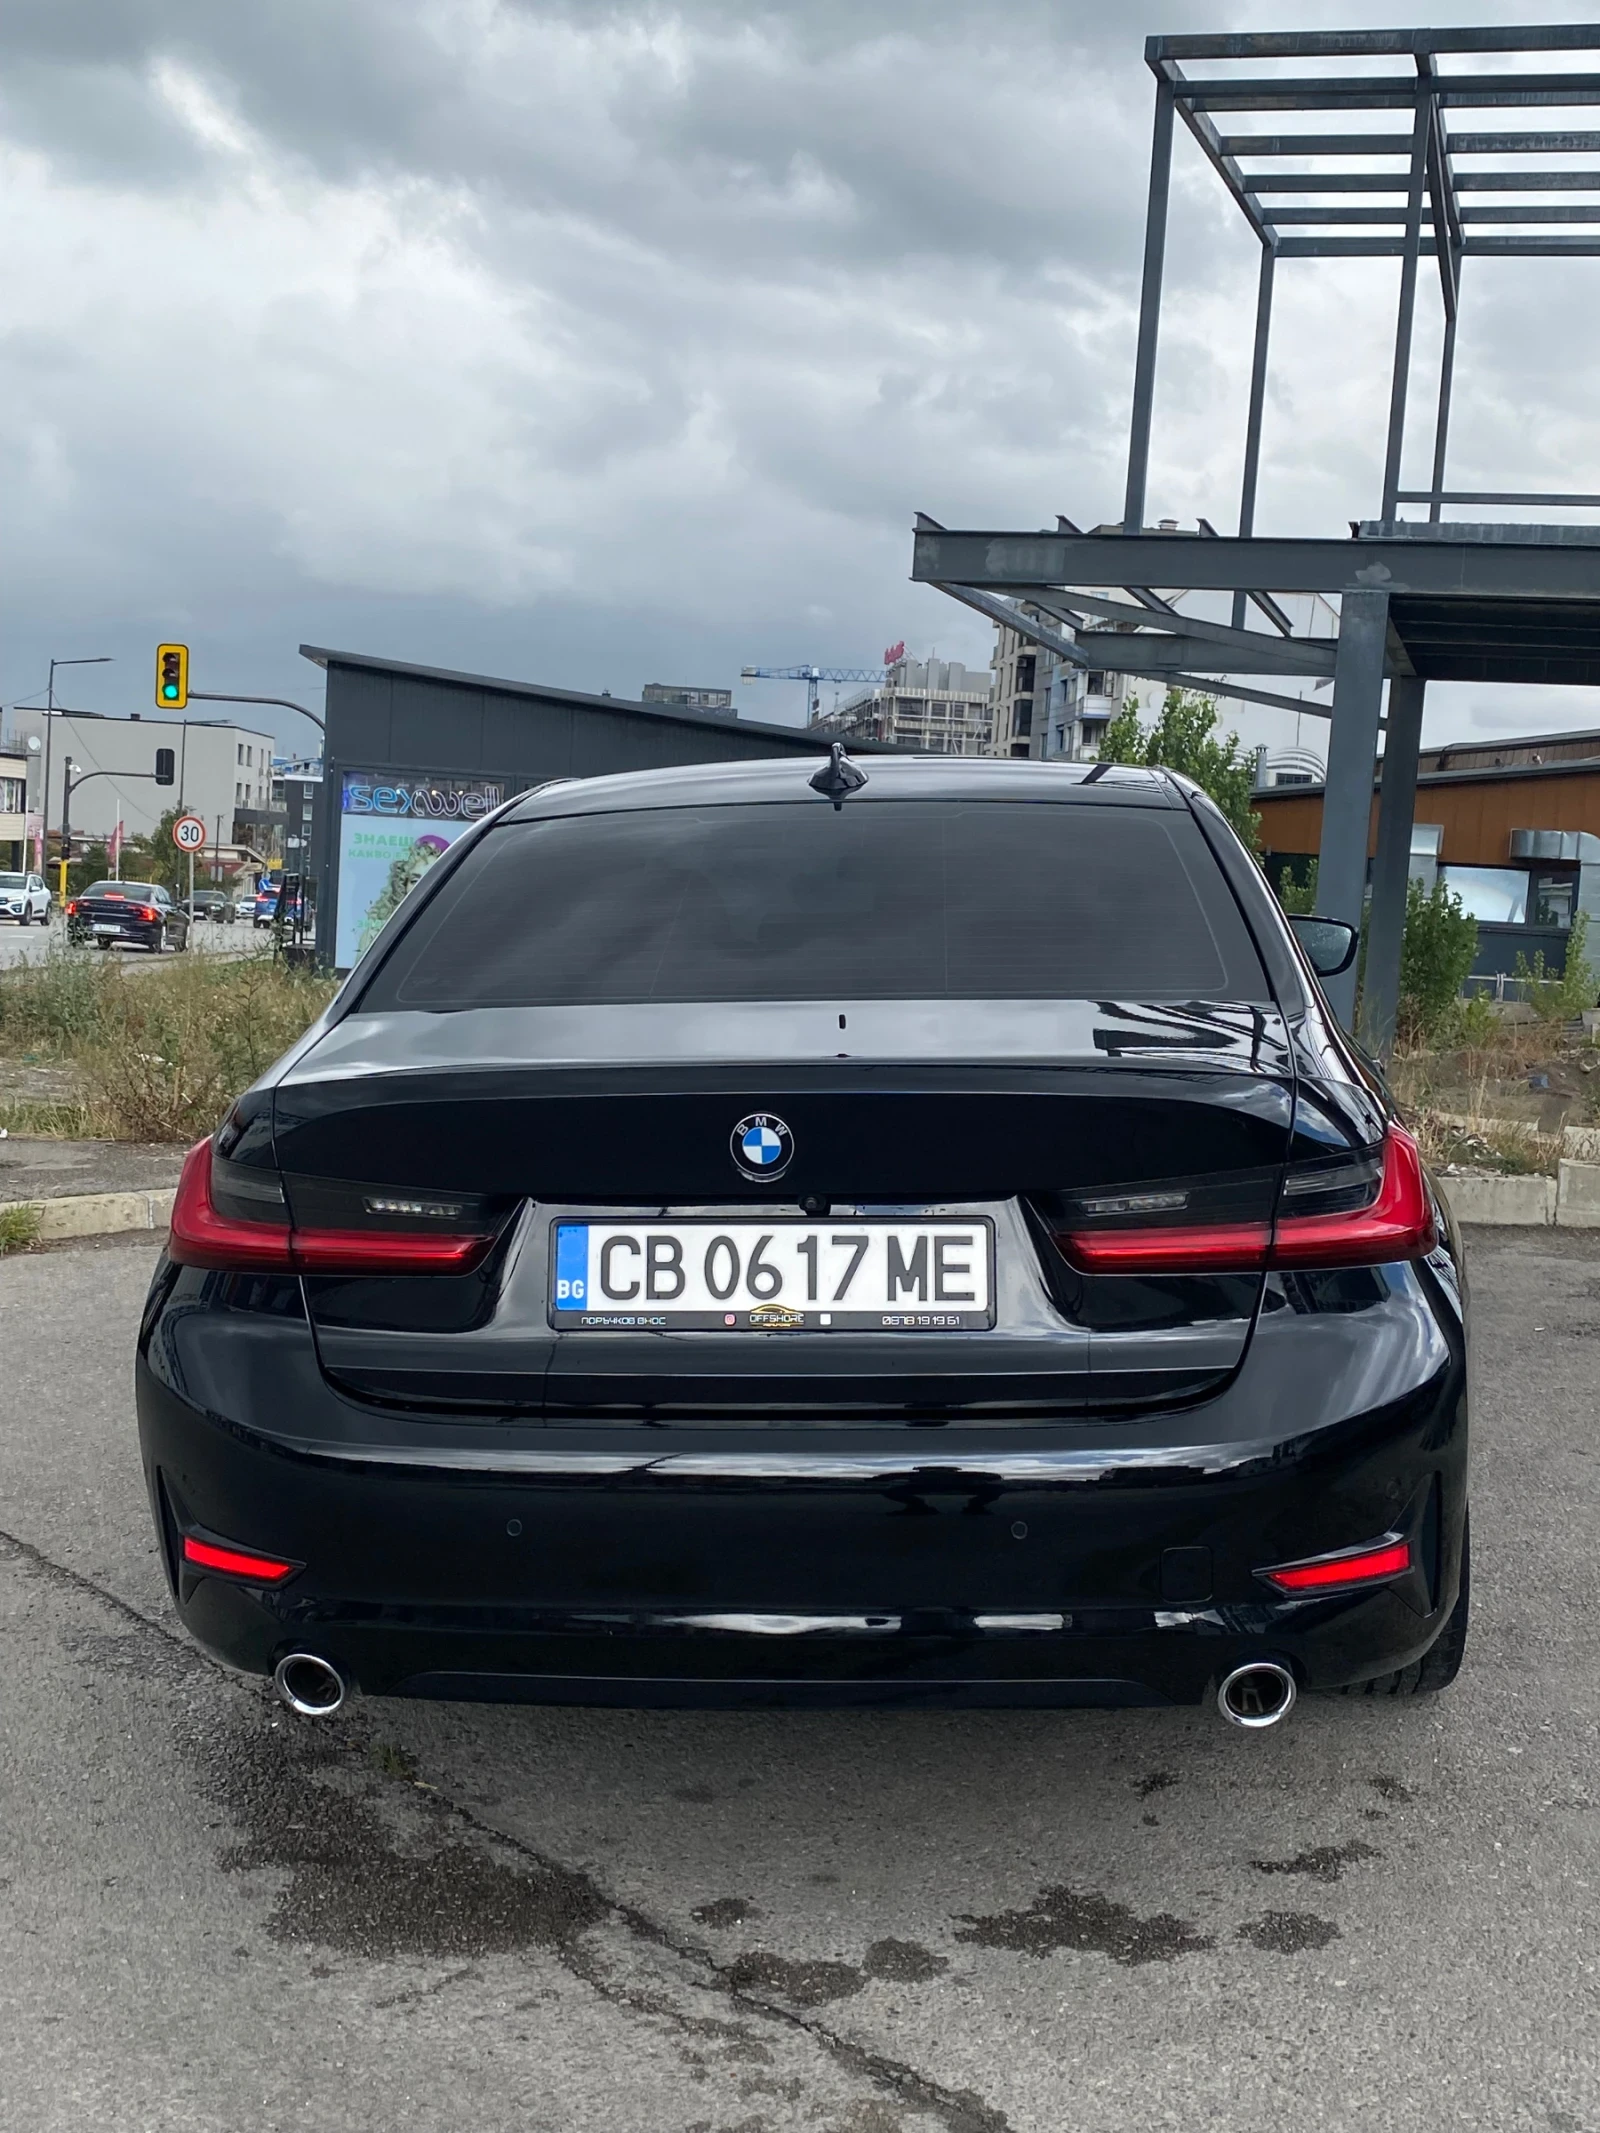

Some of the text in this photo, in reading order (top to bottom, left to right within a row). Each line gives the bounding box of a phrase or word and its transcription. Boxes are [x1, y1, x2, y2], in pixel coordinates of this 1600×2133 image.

[181, 825, 199, 842] 30
[736, 1117, 788, 1137] BMW
[600, 1235, 976, 1301] CB 0617 ME
[557, 1279, 585, 1299] BG
[637, 1316, 666, 1325] ВНОС
[749, 1314, 804, 1323] OFFSHORE
